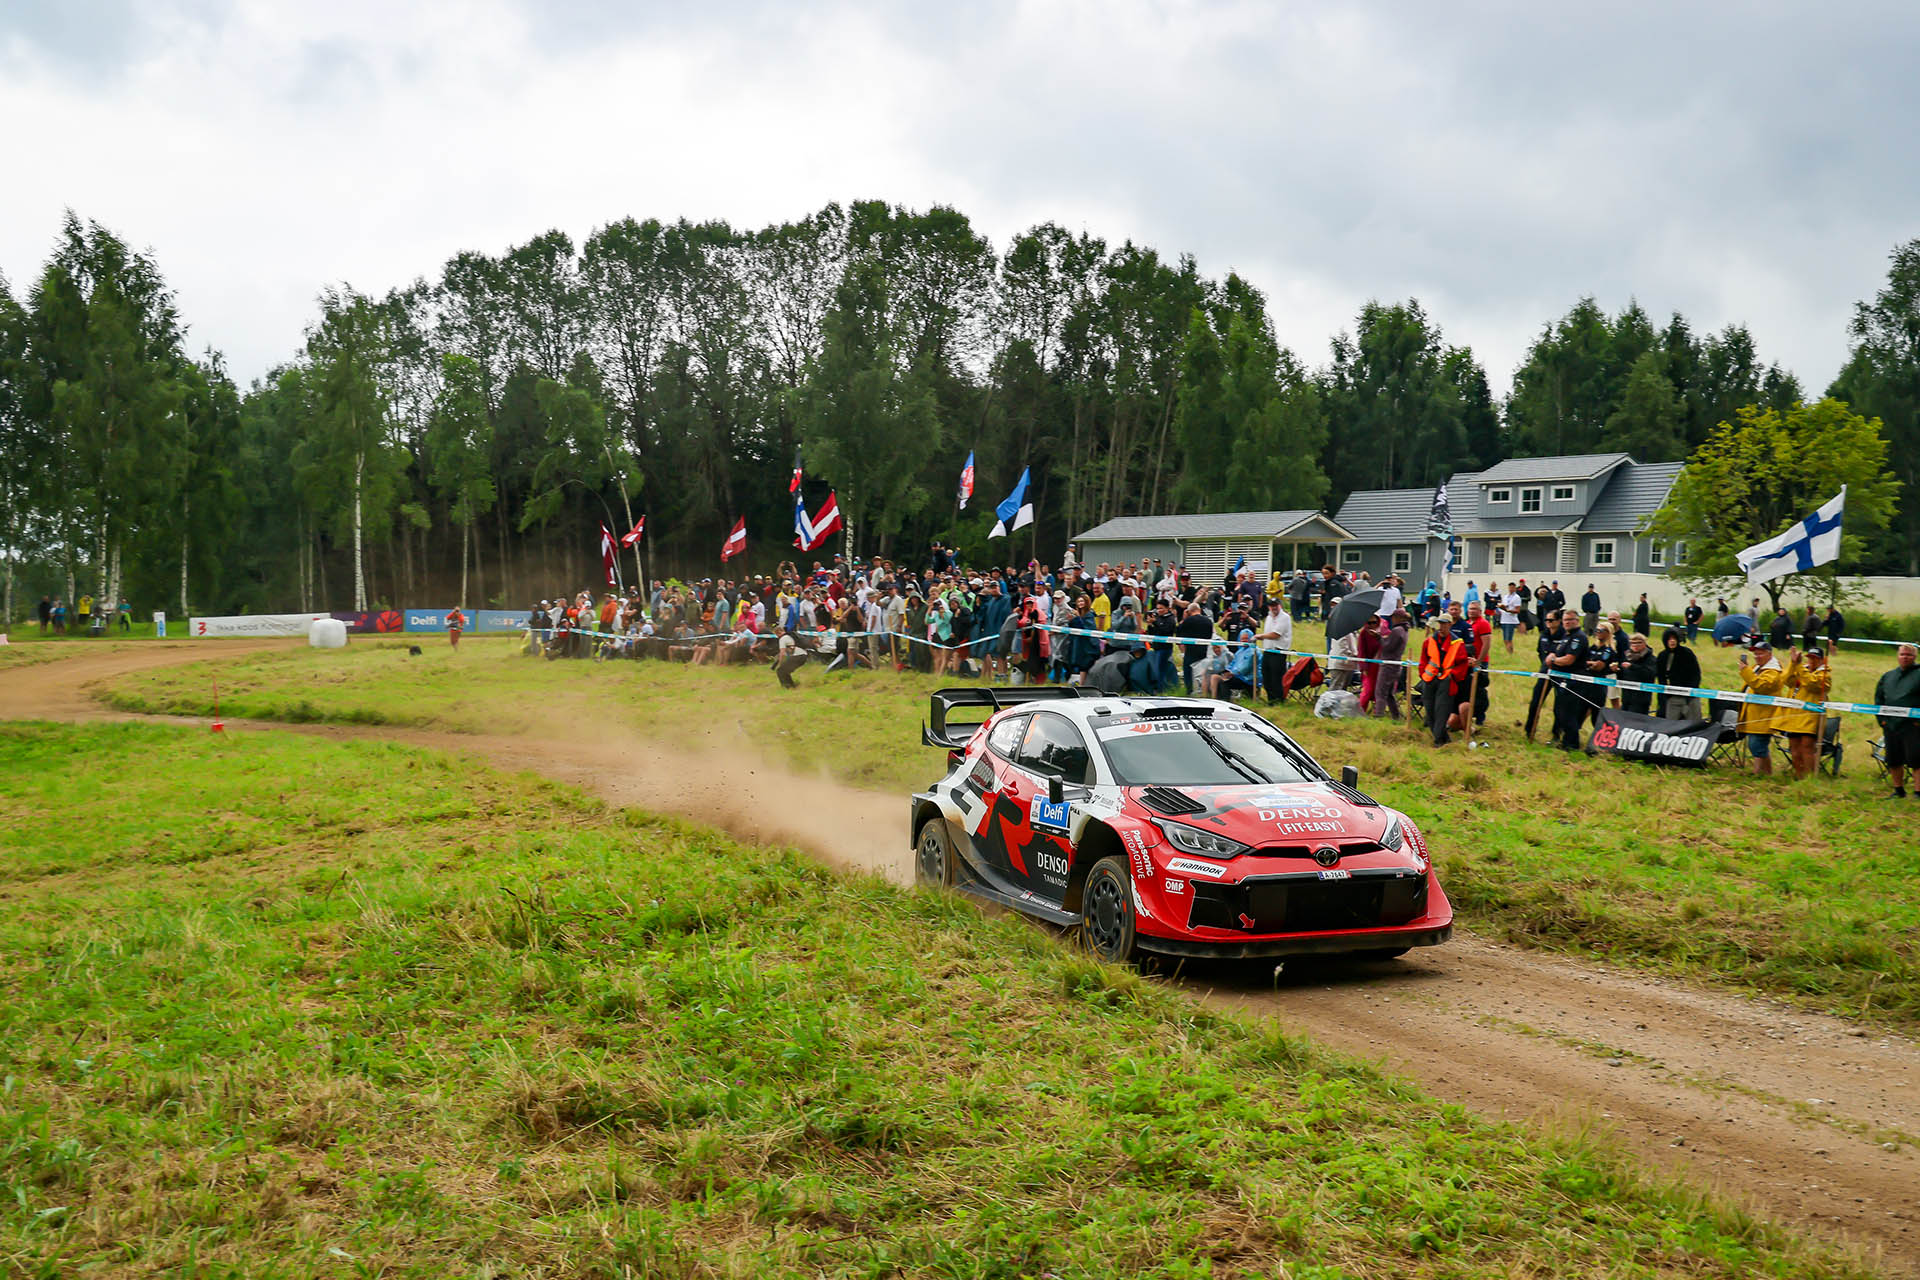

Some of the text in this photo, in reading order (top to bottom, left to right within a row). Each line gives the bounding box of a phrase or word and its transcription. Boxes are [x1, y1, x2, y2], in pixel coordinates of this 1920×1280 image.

[410, 615, 437, 626] Delfi
[1617, 727, 1655, 753] HOT
[1043, 803, 1064, 821] Delfi
[1258, 807, 1343, 822] DENSO
[1037, 851, 1068, 876] DENSO
[1121, 830, 1146, 880] AUTOMOTIVE
[1130, 829, 1155, 877] Panasonic
[1165, 880, 1184, 892] OMP
